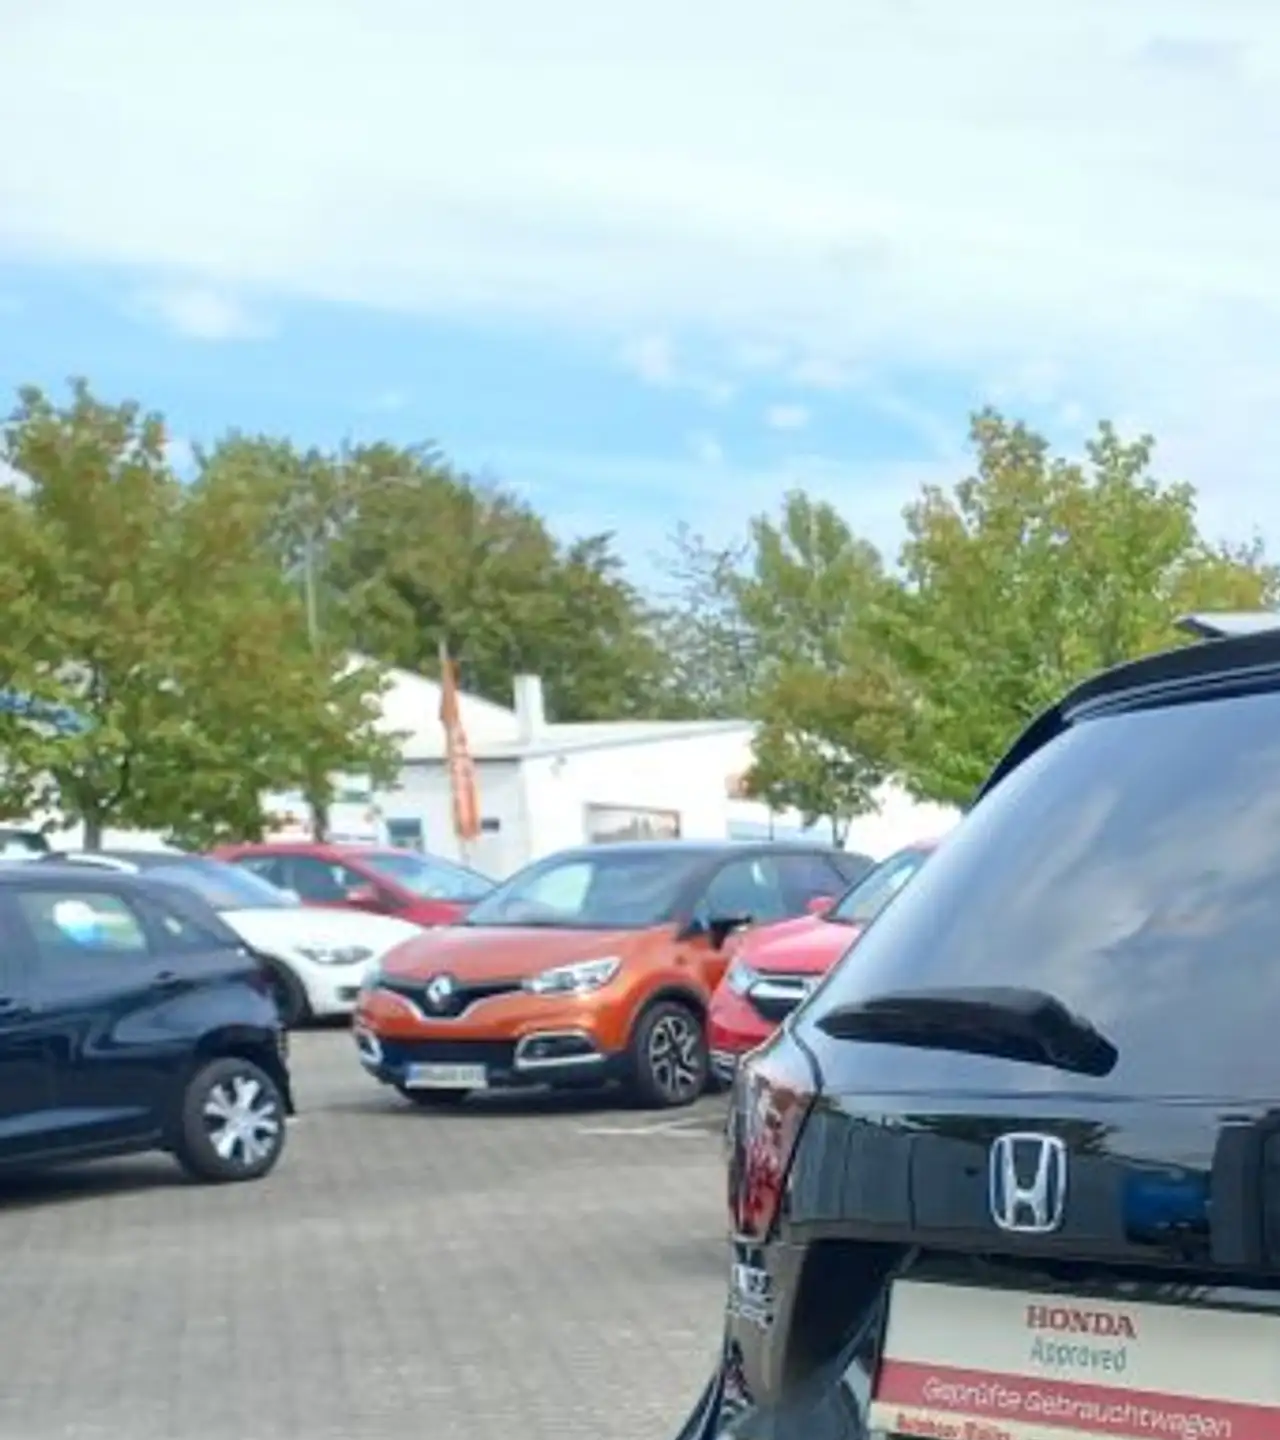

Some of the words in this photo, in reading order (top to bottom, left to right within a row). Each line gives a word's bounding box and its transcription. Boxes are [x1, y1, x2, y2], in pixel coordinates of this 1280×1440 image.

[1027, 1305, 1137, 1340] HONDA
[1030, 1337, 1127, 1374] Approved
[922, 1376, 1021, 1412] Geprüfte
[1024, 1390, 1233, 1440] Gebrauchtwagen
